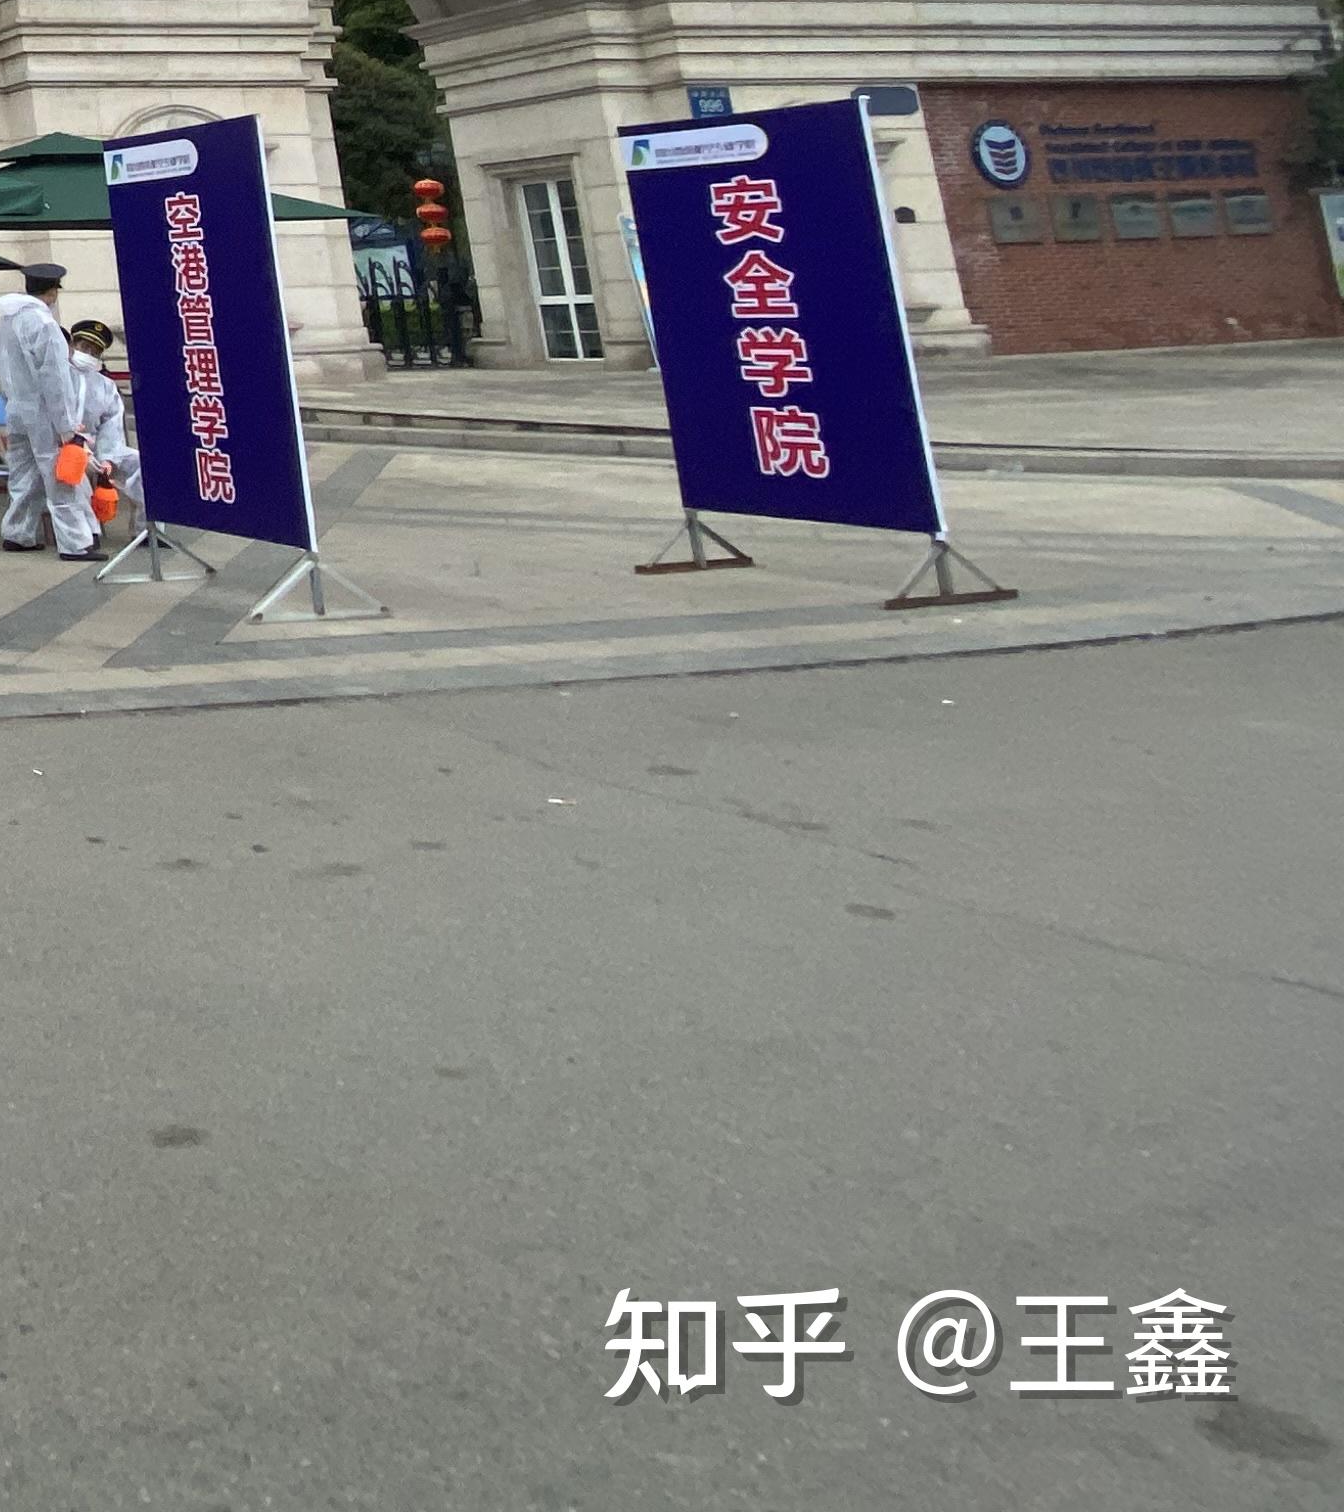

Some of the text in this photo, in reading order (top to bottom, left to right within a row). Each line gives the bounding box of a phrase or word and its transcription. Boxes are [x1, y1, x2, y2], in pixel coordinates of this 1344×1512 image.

[164, 191, 236, 504] 空港管理学院
[709, 174, 830, 479] 安全学院
